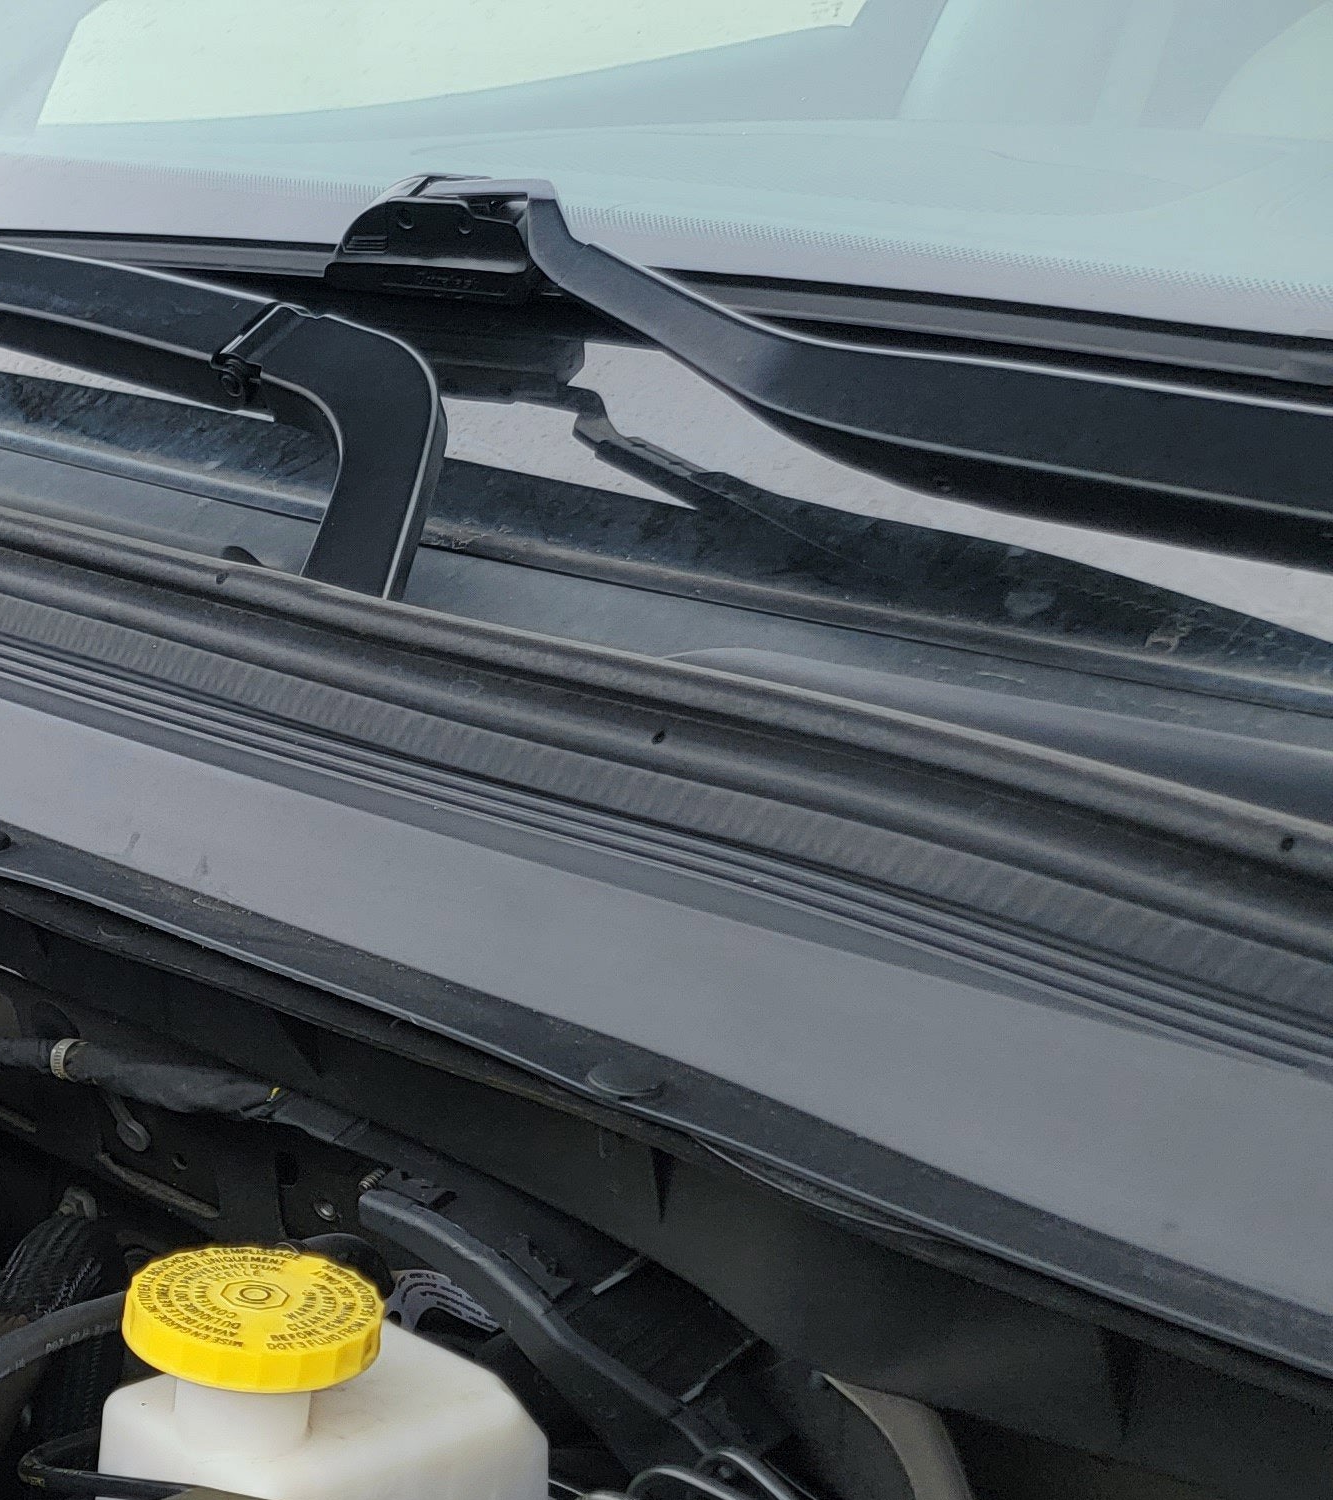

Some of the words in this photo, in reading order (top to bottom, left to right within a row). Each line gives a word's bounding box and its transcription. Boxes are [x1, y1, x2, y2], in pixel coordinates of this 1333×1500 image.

[202, 1255, 288, 1266] UNIQUEMENT
[214, 1248, 300, 1261] REMPLISSAGE
[269, 1328, 324, 1341] BEFORE
[266, 1342, 293, 1350] DOT
